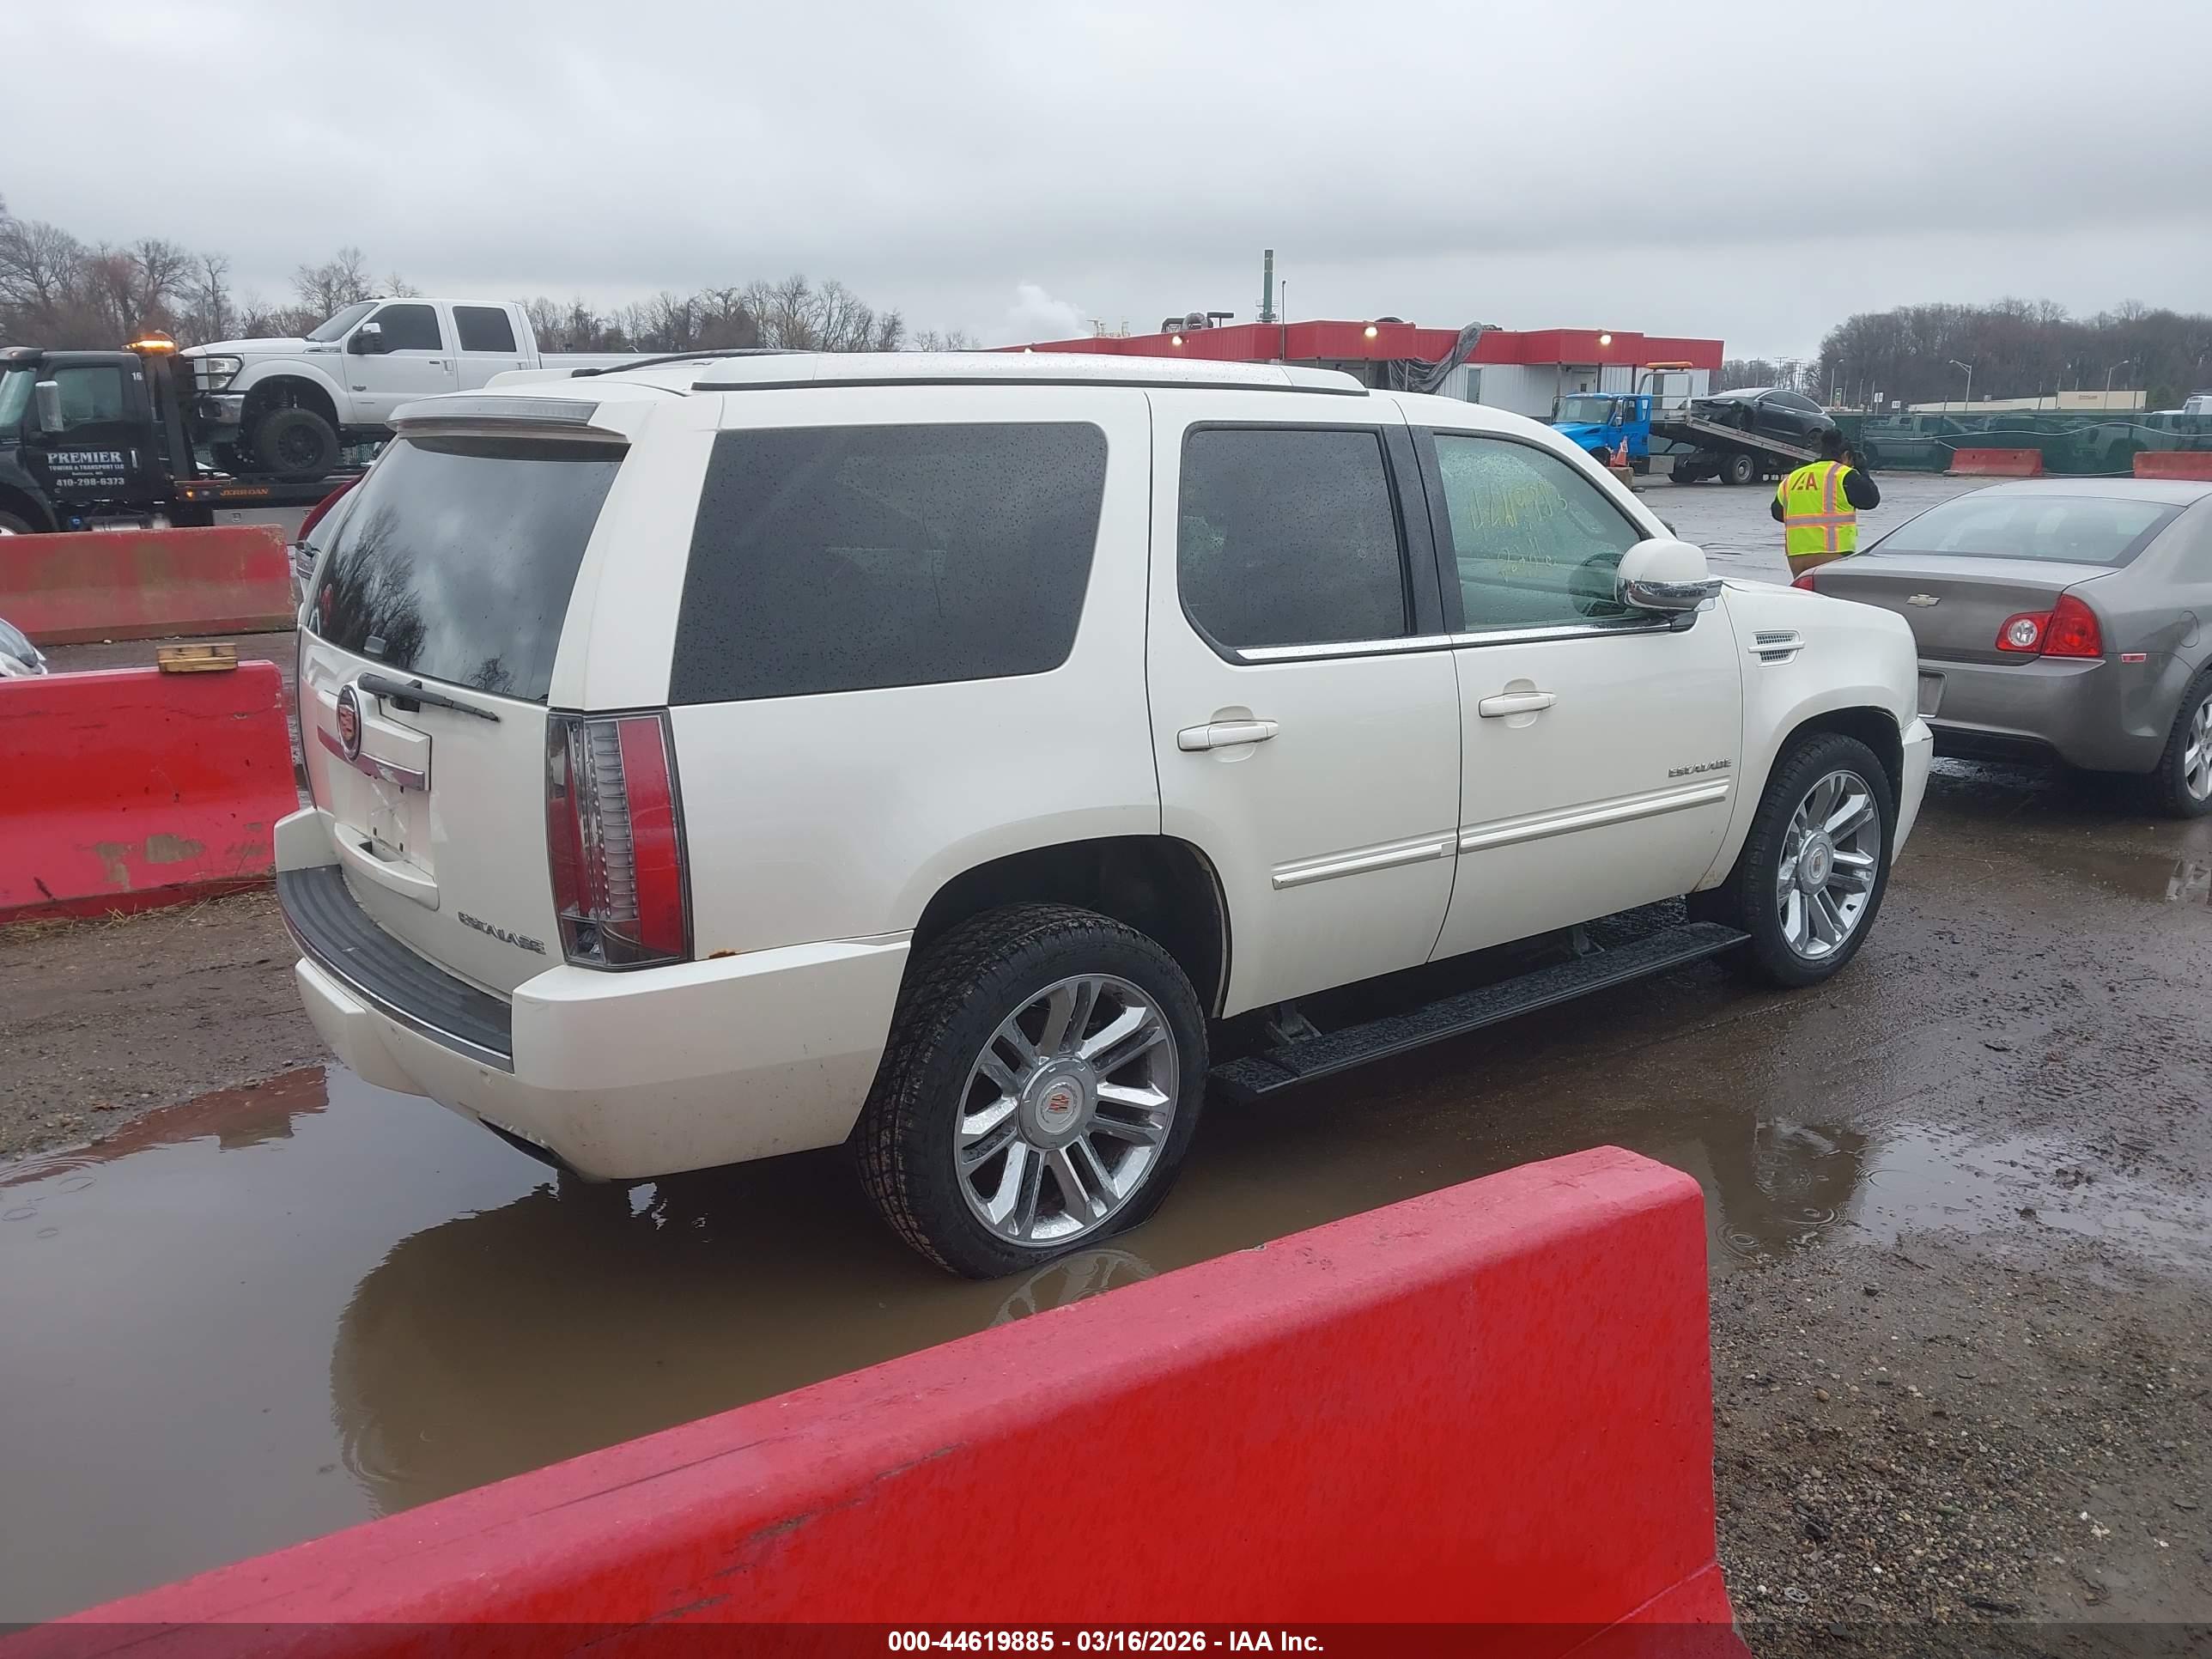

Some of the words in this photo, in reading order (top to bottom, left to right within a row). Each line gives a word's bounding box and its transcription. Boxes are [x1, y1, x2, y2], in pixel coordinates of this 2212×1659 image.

[46, 452, 123, 464] PREMIER
[1668, 758, 1732, 777] ESCALADE
[457, 910, 547, 956] ESCALADE
